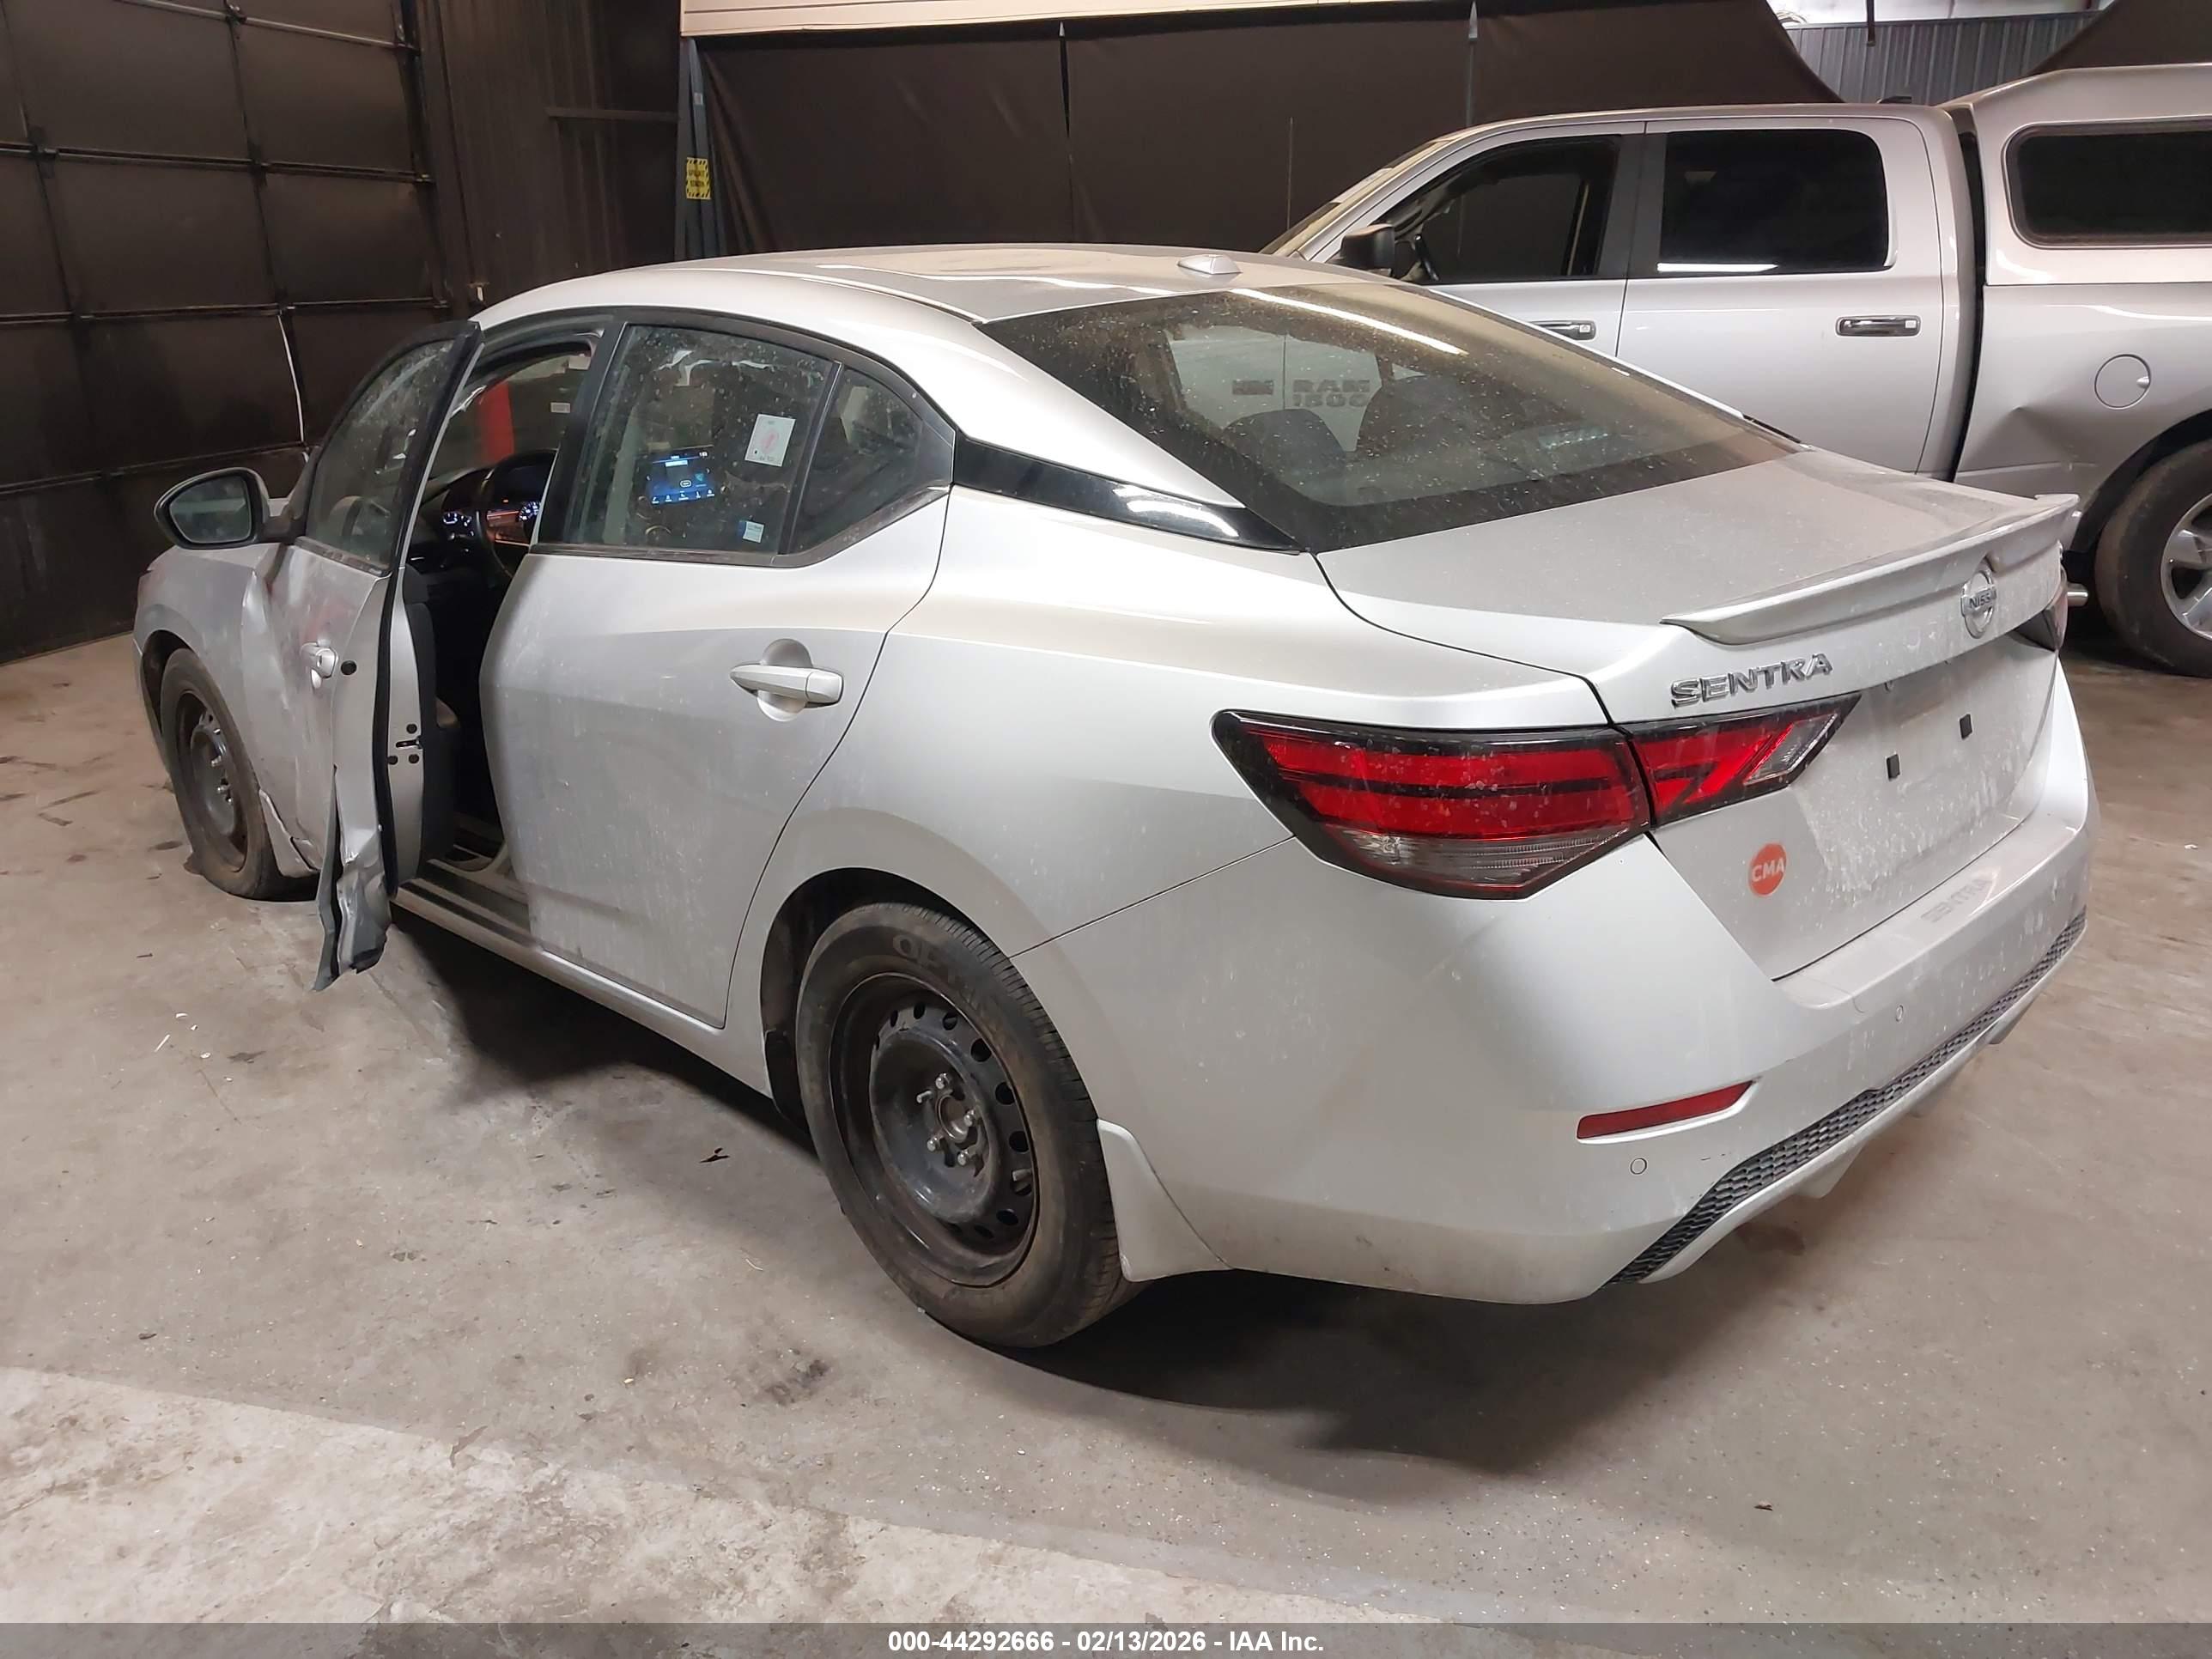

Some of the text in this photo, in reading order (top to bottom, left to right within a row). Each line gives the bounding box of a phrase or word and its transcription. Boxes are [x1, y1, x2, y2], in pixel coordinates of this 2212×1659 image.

[1292, 379, 1370, 392] RAM
[1292, 392, 1369, 407] 1500
[1671, 653, 1832, 708] SENTRA
[1751, 858, 1784, 883] CMA
